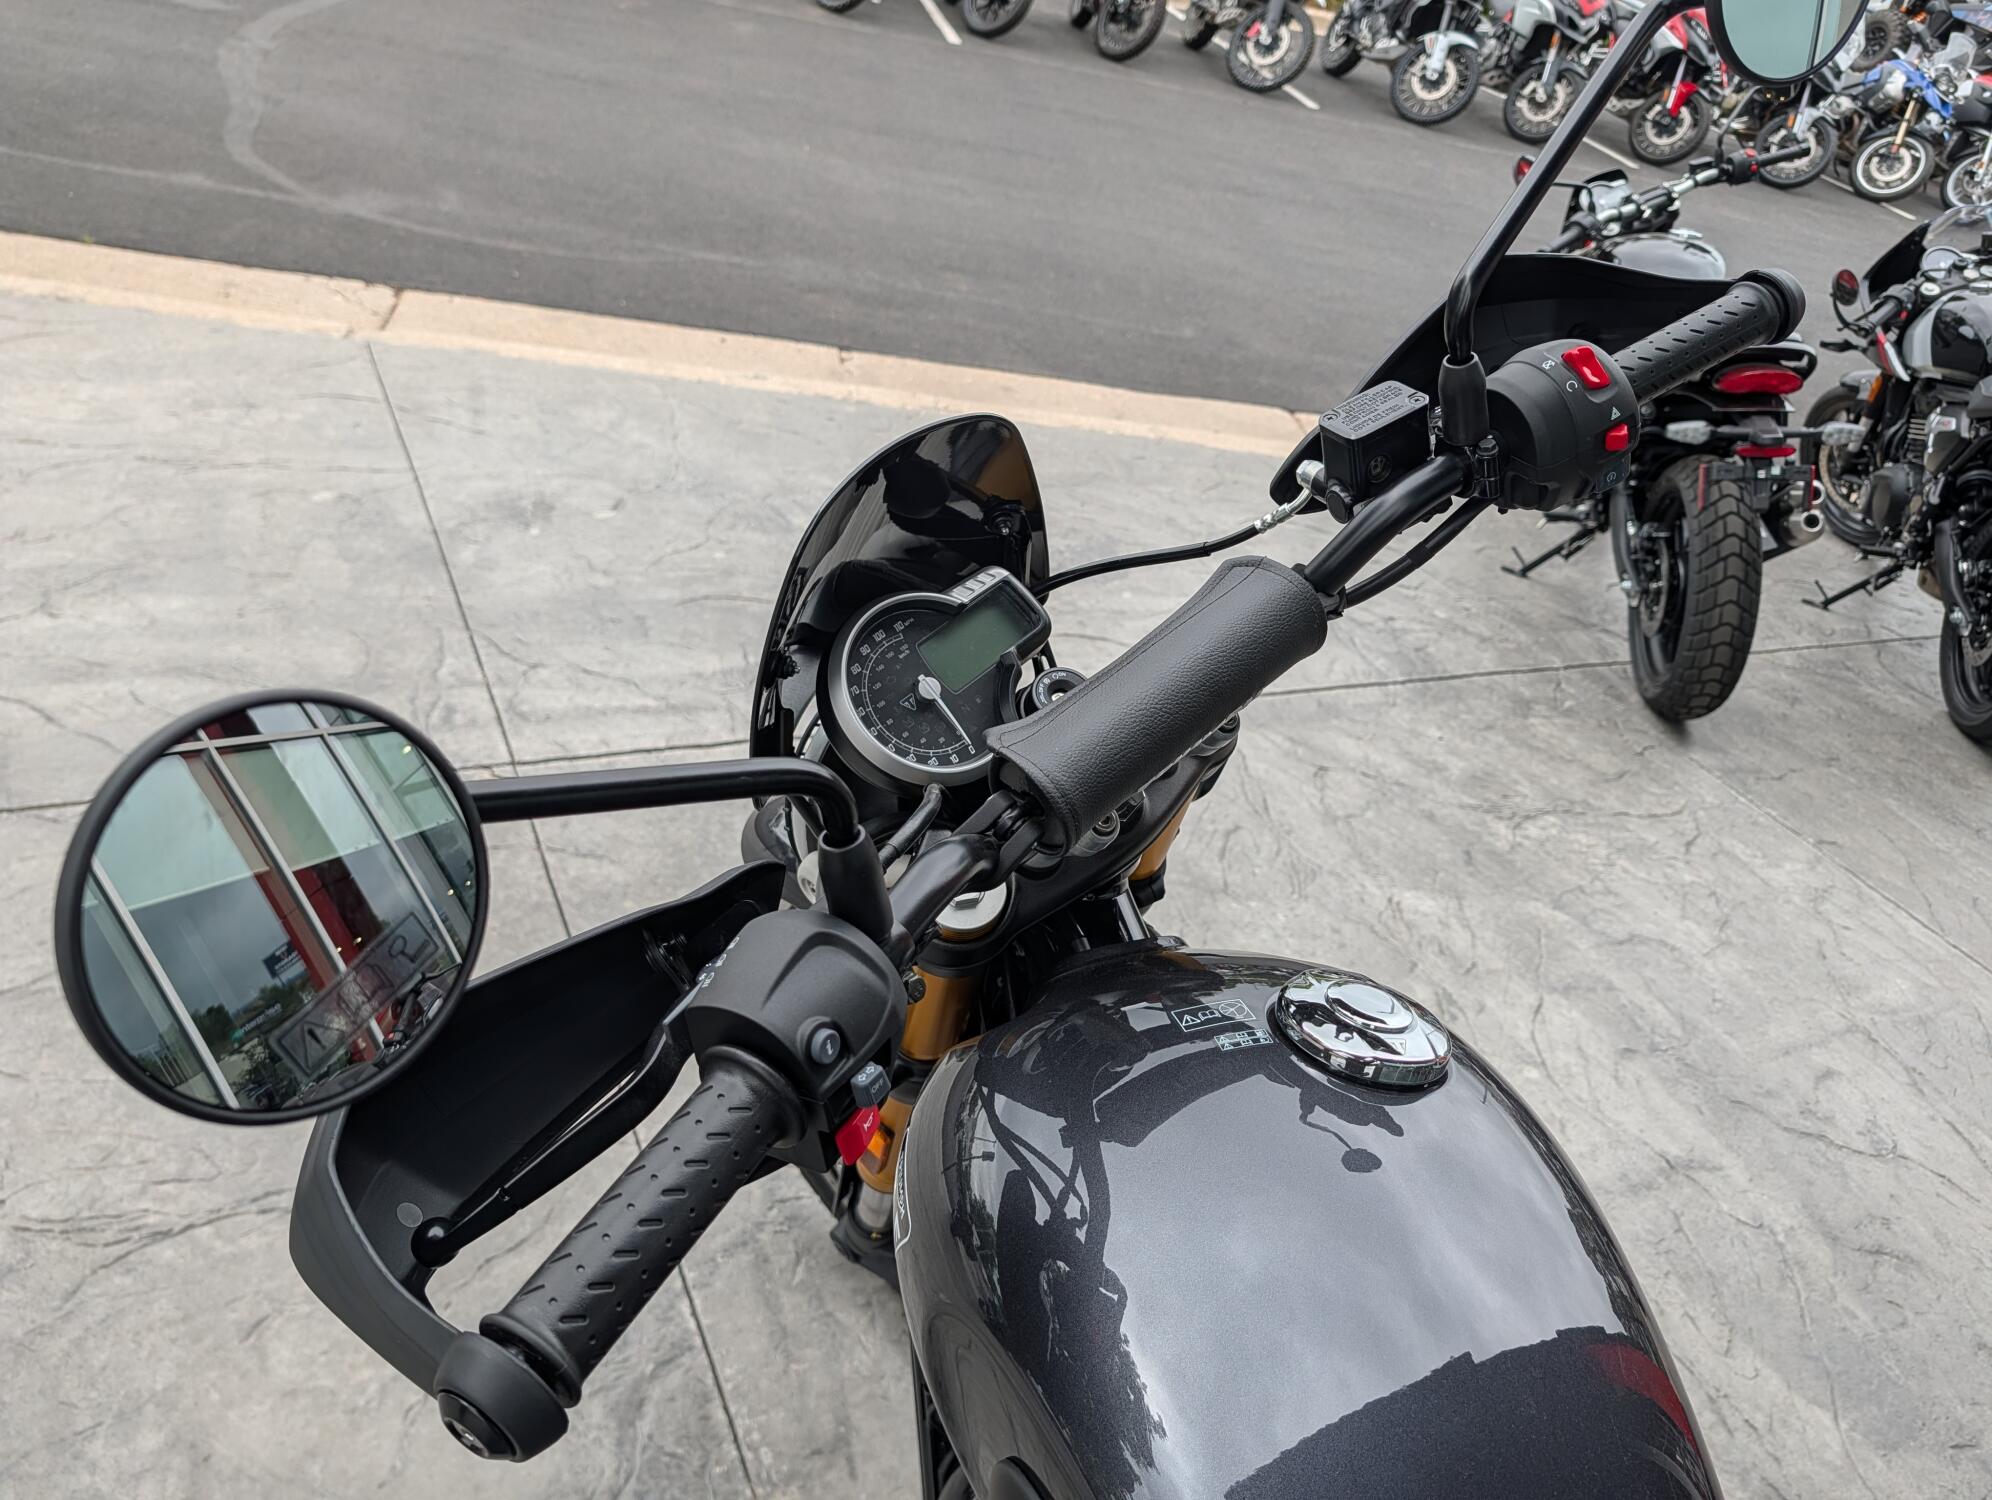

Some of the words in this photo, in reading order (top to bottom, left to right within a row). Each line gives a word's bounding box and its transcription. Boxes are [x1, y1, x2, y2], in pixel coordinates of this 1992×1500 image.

[893, 620, 905, 632] 110
[872, 629, 886, 642] 100
[860, 643, 872, 656] 90
[850, 663, 862, 675] 80
[850, 684, 860, 697] 70
[968, 744, 976, 755] 0
[927, 756, 939, 766] 20
[949, 753, 960, 764] 10
